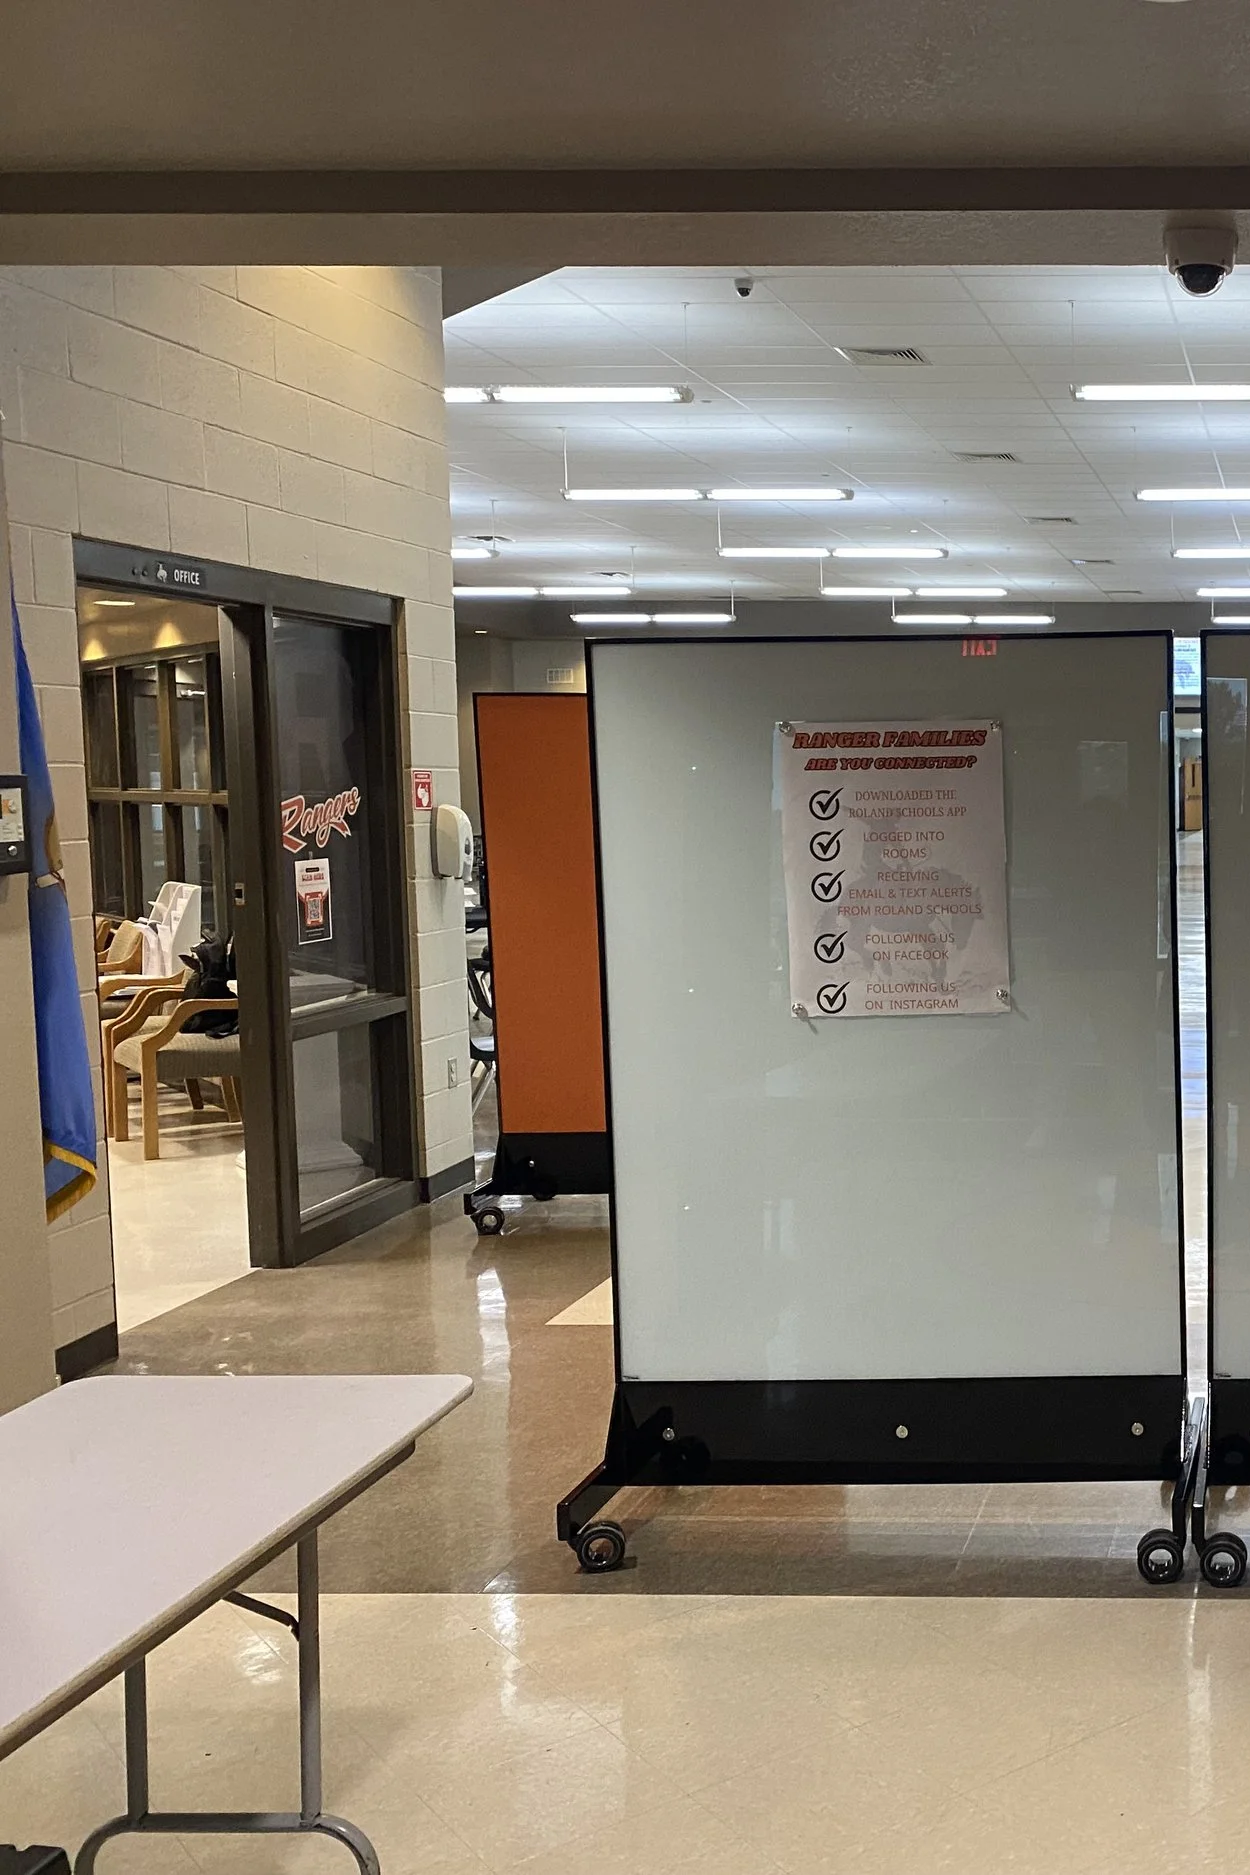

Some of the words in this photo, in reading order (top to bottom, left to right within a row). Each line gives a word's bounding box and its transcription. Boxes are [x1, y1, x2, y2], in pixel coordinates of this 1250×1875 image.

[173, 569, 200, 585] OFFICE
[793, 731, 881, 749] RANGER
[882, 730, 987, 747] FAMILIES
[804, 758, 837, 771] ARE
[840, 757, 874, 770] YOU
[874, 756, 977, 770] CONNECTED?
[855, 790, 934, 801] DOWNLOADED
[935, 789, 957, 800] THE
[849, 808, 894, 819] ROLAND
[896, 807, 945, 818] SCHOOLS
[946, 807, 967, 817] APP
[281, 786, 361, 853] Rangers
[863, 831, 913, 842] LOGGED
[915, 831, 945, 842] INTO
[882, 848, 927, 859] ROOMS
[877, 871, 940, 882] RECEIVING
[849, 888, 885, 899] EMAIL
[888, 888, 897, 898] &
[900, 887, 927, 898] TEXT
[929, 887, 972, 898] ALERTS
[837, 905, 871, 917] FROM
[874, 904, 923, 916] ROLAND
[926, 903, 982, 915] SCHOOLS
[865, 933, 937, 944] FOLLOWING
[938, 932, 955, 943] US
[872, 950, 891, 961] ON
[894, 950, 949, 961] FACEOOK
[866, 983, 938, 994] FOLLOWING
[940, 982, 956, 993] US
[865, 1000, 883, 1010] ON
[890, 998, 959, 1010] INSTAGRAM
